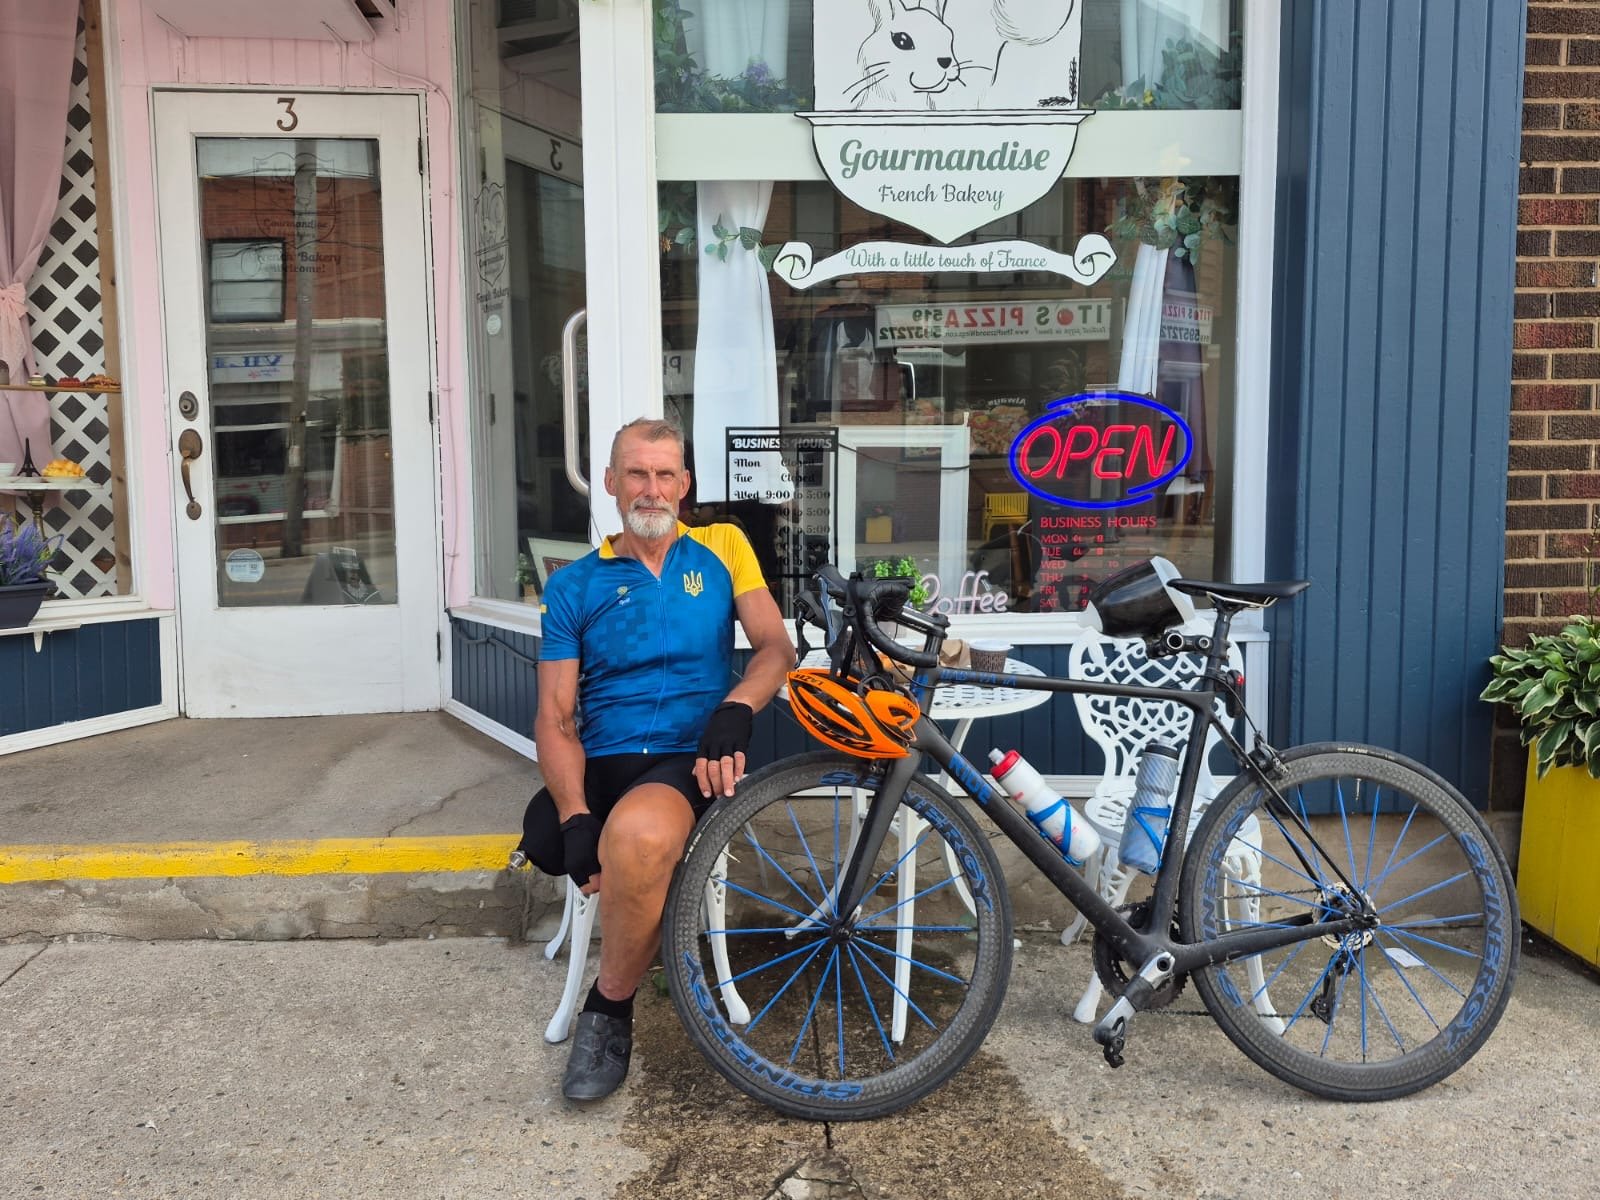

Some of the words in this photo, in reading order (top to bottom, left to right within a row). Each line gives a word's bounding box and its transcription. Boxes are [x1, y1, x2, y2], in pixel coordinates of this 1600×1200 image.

[277, 97, 298, 132] 3
[839, 139, 1051, 179] Gourmandise
[878, 184, 939, 203] French
[941, 184, 1004, 211] Bakery
[845, 249, 885, 268] With
[890, 257, 899, 267] a
[903, 250, 936, 267] little
[938, 250, 979, 267] touch
[981, 250, 994, 272] of
[996, 249, 1048, 268] France
[732, 438, 790, 449] BUSINESS
[793, 438, 832, 449] HOURS
[1019, 424, 1176, 479] OPEN
[734, 458, 760, 468] Mon
[734, 473, 753, 483] Tue
[734, 490, 760, 499] Wed
[765, 490, 791, 499] 9:00
[806, 490, 831, 499] 5:00
[806, 508, 831, 516] 5:00
[1040, 516, 1102, 528] BUSINESS
[1107, 516, 1157, 528] HOURS
[1041, 534, 1068, 544] MON
[1041, 547, 1061, 556] TUE
[1040, 560, 1066, 569] WED
[1040, 573, 1063, 582] THU
[1040, 586, 1056, 594] FRI
[1040, 599, 1058, 608] SAT
[948, 751, 993, 805] RIDE
[820, 770, 993, 913] SNERGY
[1447, 831, 1504, 1050] SPINERGY
[683, 950, 864, 1100] SPINERGY
